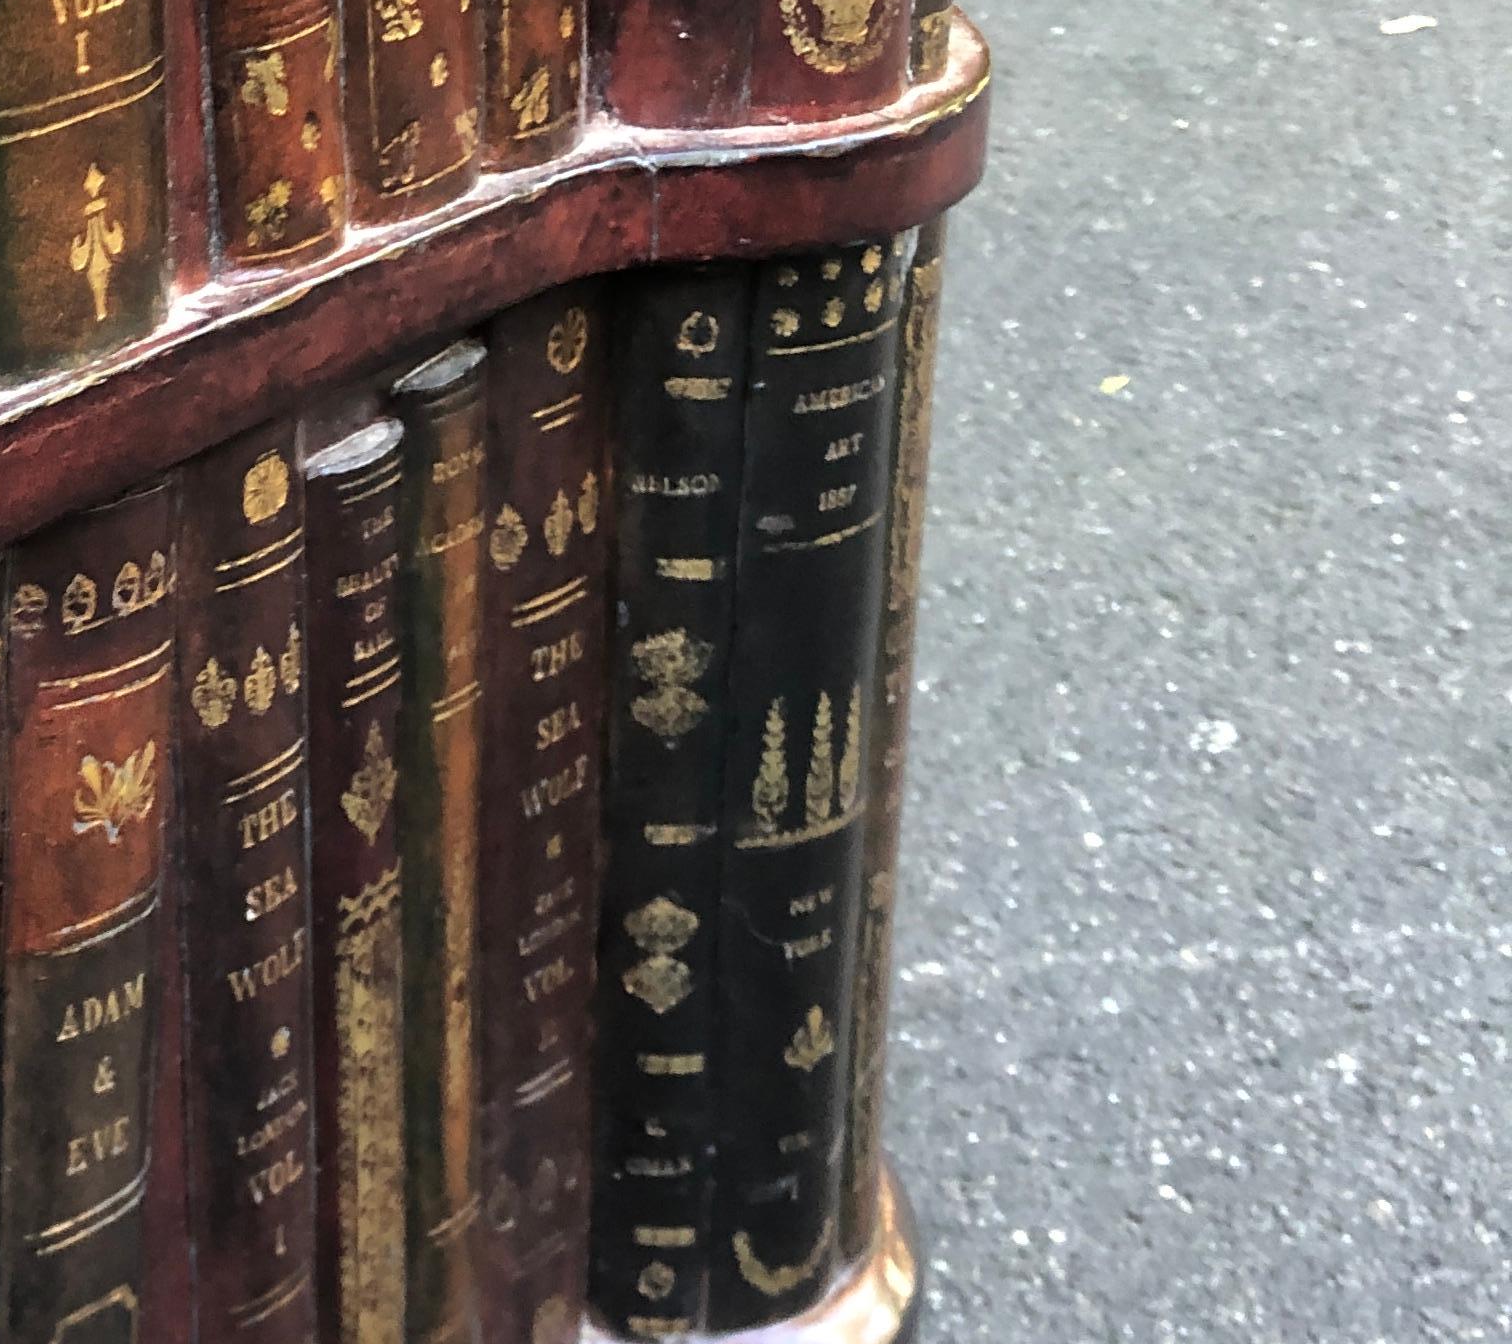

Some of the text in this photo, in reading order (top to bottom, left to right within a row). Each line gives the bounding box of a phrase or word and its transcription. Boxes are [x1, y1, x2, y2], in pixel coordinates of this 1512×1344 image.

[74, 29, 91, 74] I
[240, 787, 299, 850] THE
[55, 972, 146, 1044] ADAM
[92, 1056, 117, 1095] &
[65, 1116, 131, 1178] EVE
